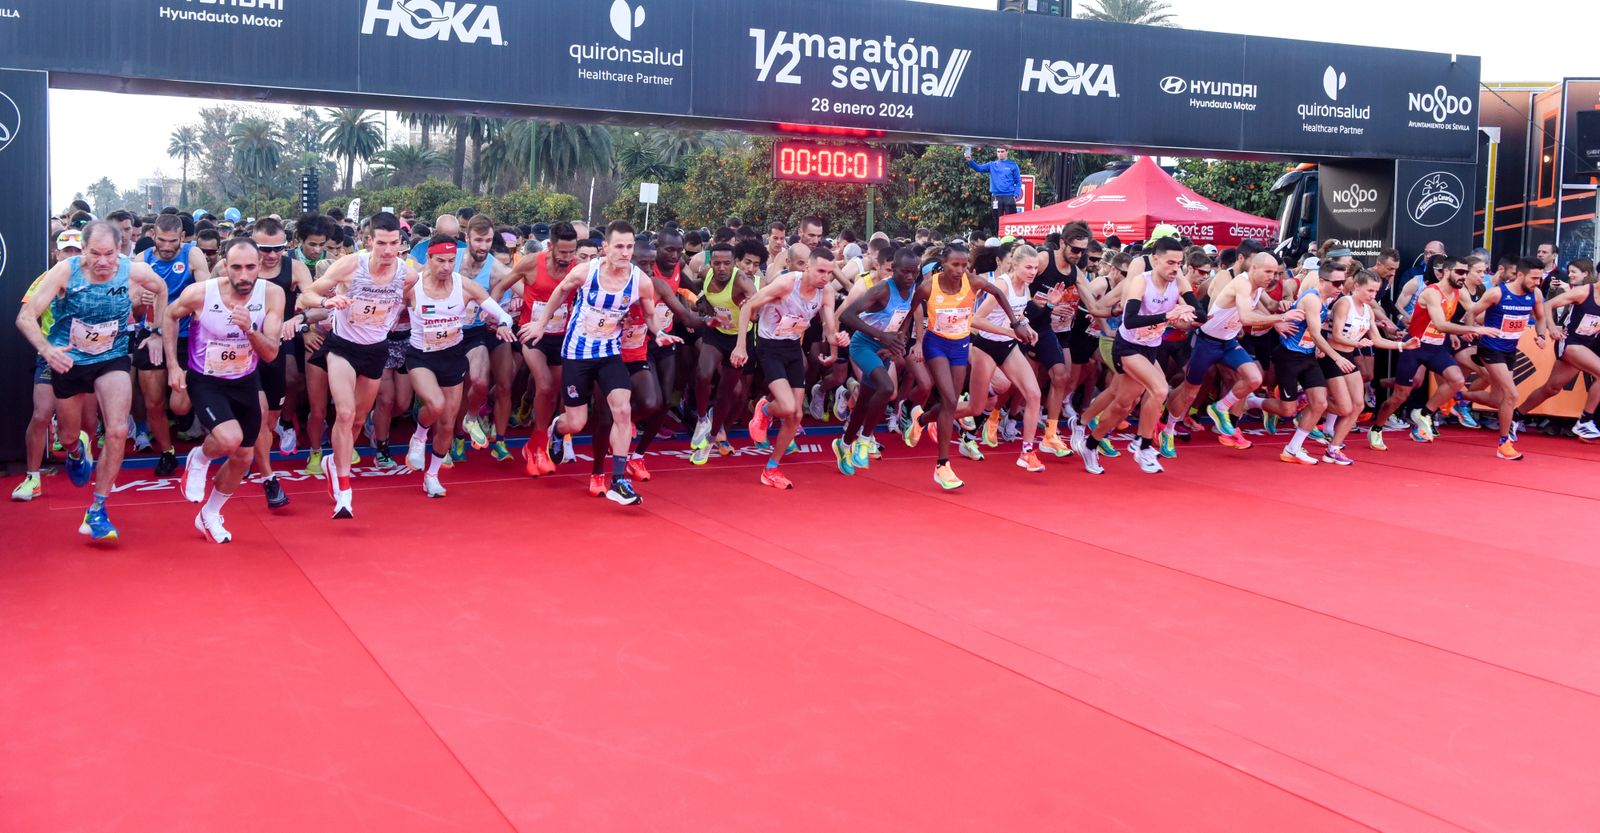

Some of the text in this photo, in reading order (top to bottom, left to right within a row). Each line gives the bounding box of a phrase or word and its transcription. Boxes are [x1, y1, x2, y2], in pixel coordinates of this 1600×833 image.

[0, 8, 20, 18] ILLA
[159, 6, 283, 28] Hyundauto Motor
[361, 0, 503, 46] HOKA
[569, 43, 684, 67] quirónsalud
[793, 32, 939, 69] maratón
[578, 68, 674, 86] Healthcare Partner
[831, 62, 941, 96] sevilla
[1021, 58, 1118, 98] HOKA
[1190, 80, 1258, 98] HYUNDAI
[811, 97, 914, 118] 28 enero 2024
[1189, 98, 1257, 111] Hyundauto Motor
[1302, 123, 1364, 135] Healthcare Partner
[780, 147, 883, 179] 00:00:01
[1229, 223, 1274, 239] alssport.
[363, 305, 377, 315] 51
[598, 318, 605, 328] 8
[947, 315, 958, 324] 15
[85, 330, 99, 342] 72
[436, 330, 448, 340] 54
[626, 330, 634, 339] 3
[221, 350, 237, 361] 66
